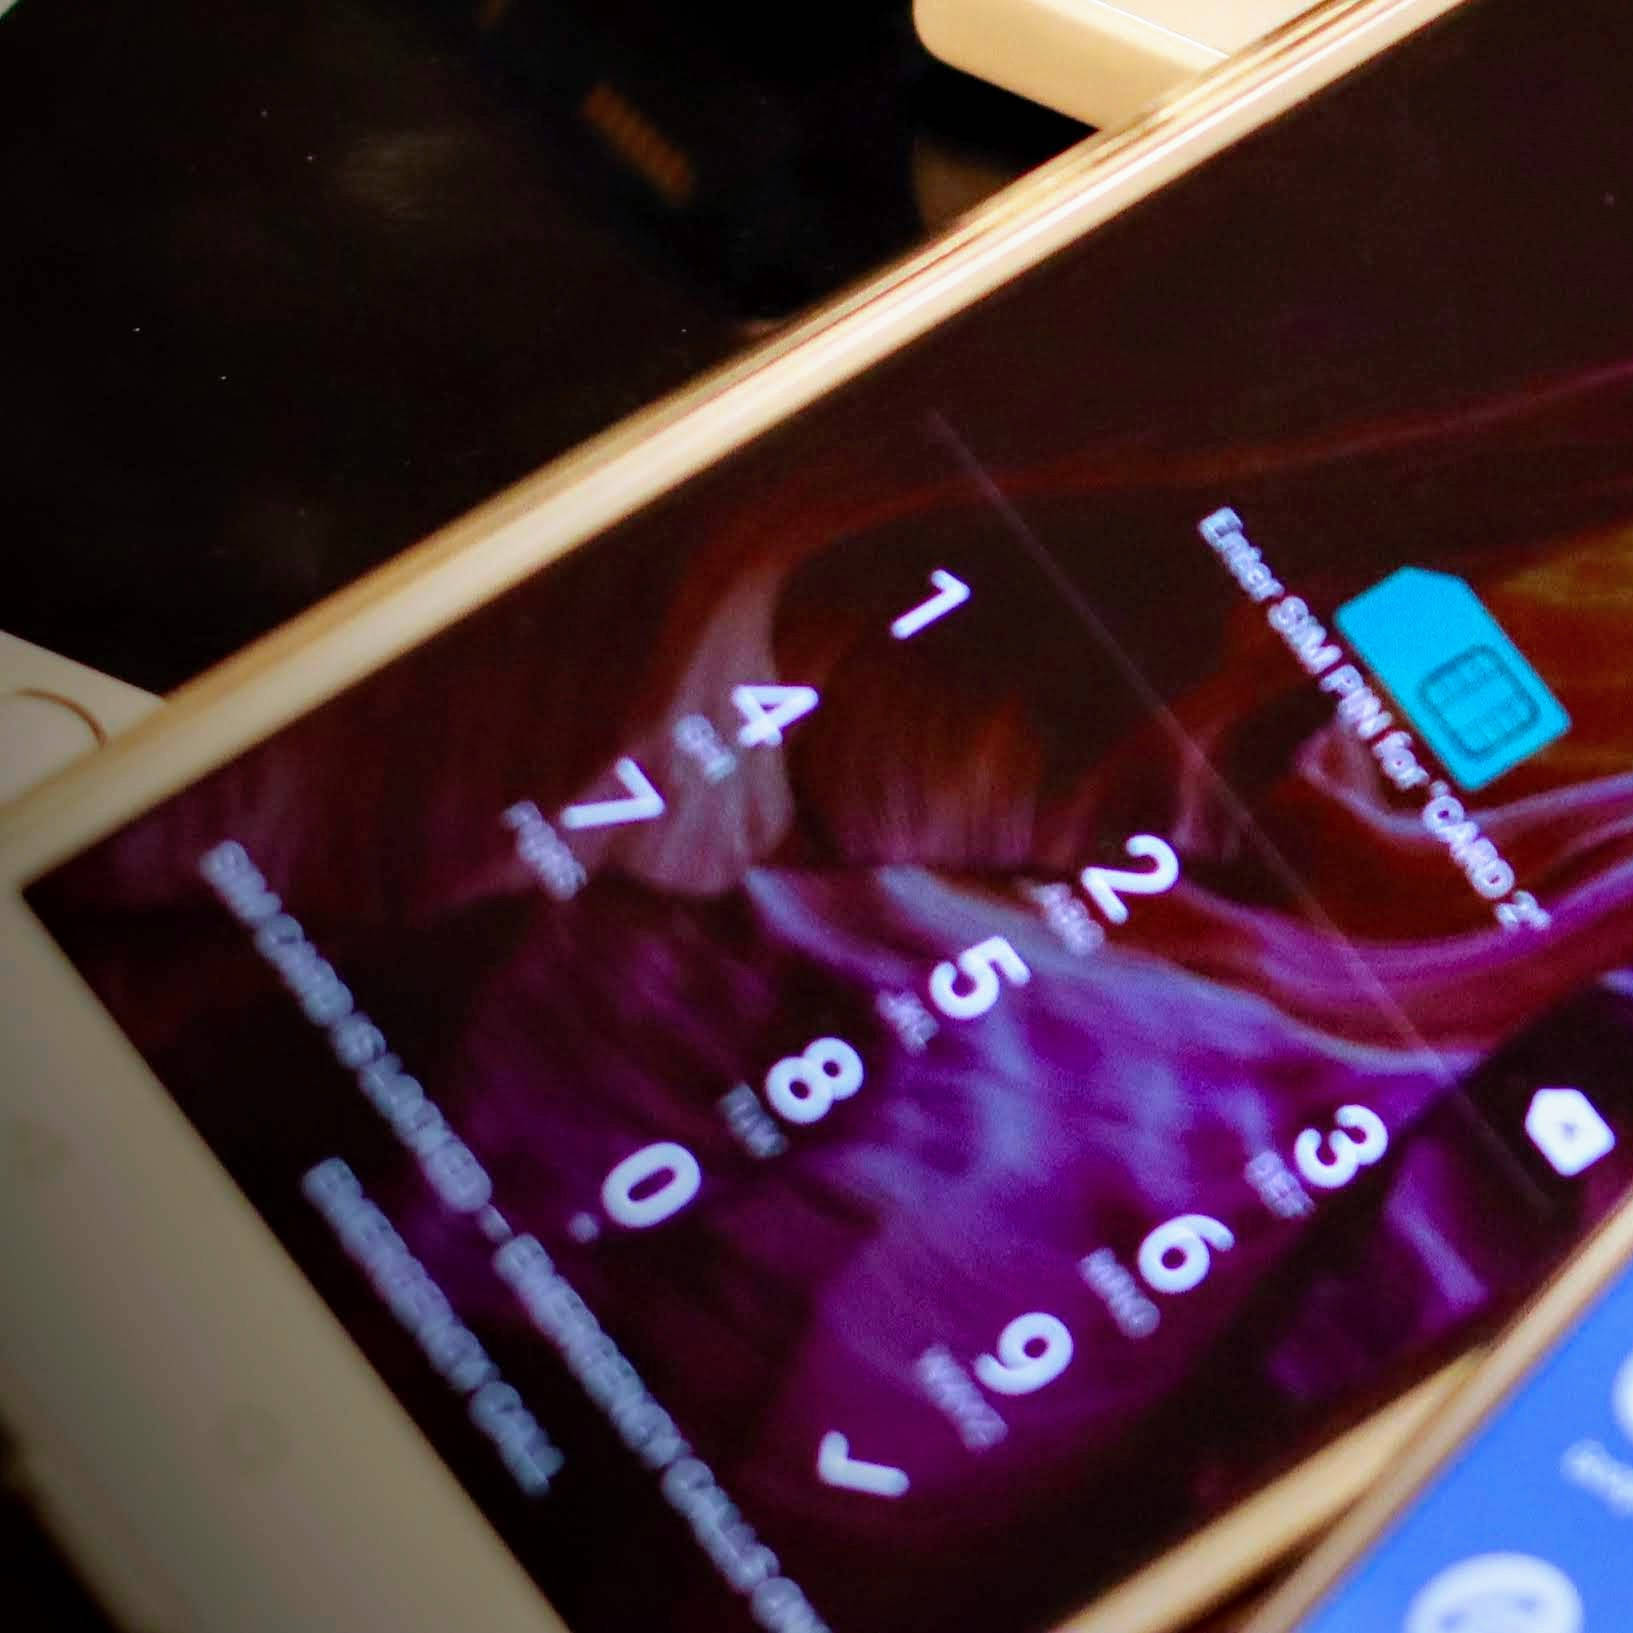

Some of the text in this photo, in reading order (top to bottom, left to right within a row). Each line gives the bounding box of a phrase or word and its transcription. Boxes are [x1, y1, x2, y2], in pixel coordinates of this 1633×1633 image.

[889, 567, 972, 641] 1
[1199, 506, 1284, 602] Enter
[1267, 594, 1343, 676] SIM
[1319, 663, 1393, 739] PIN
[1372, 730, 1431, 790] for
[730, 682, 821, 748] 4
[558, 756, 666, 831] 7
[1080, 832, 1180, 925] 2
[928, 934, 1033, 1021] 5
[764, 1035, 865, 1126] 8
[601, 1140, 702, 1230] 0
[1292, 1103, 1390, 1190] 3
[1136, 1212, 1236, 1295] 6
[972, 1310, 1075, 1397] 9
